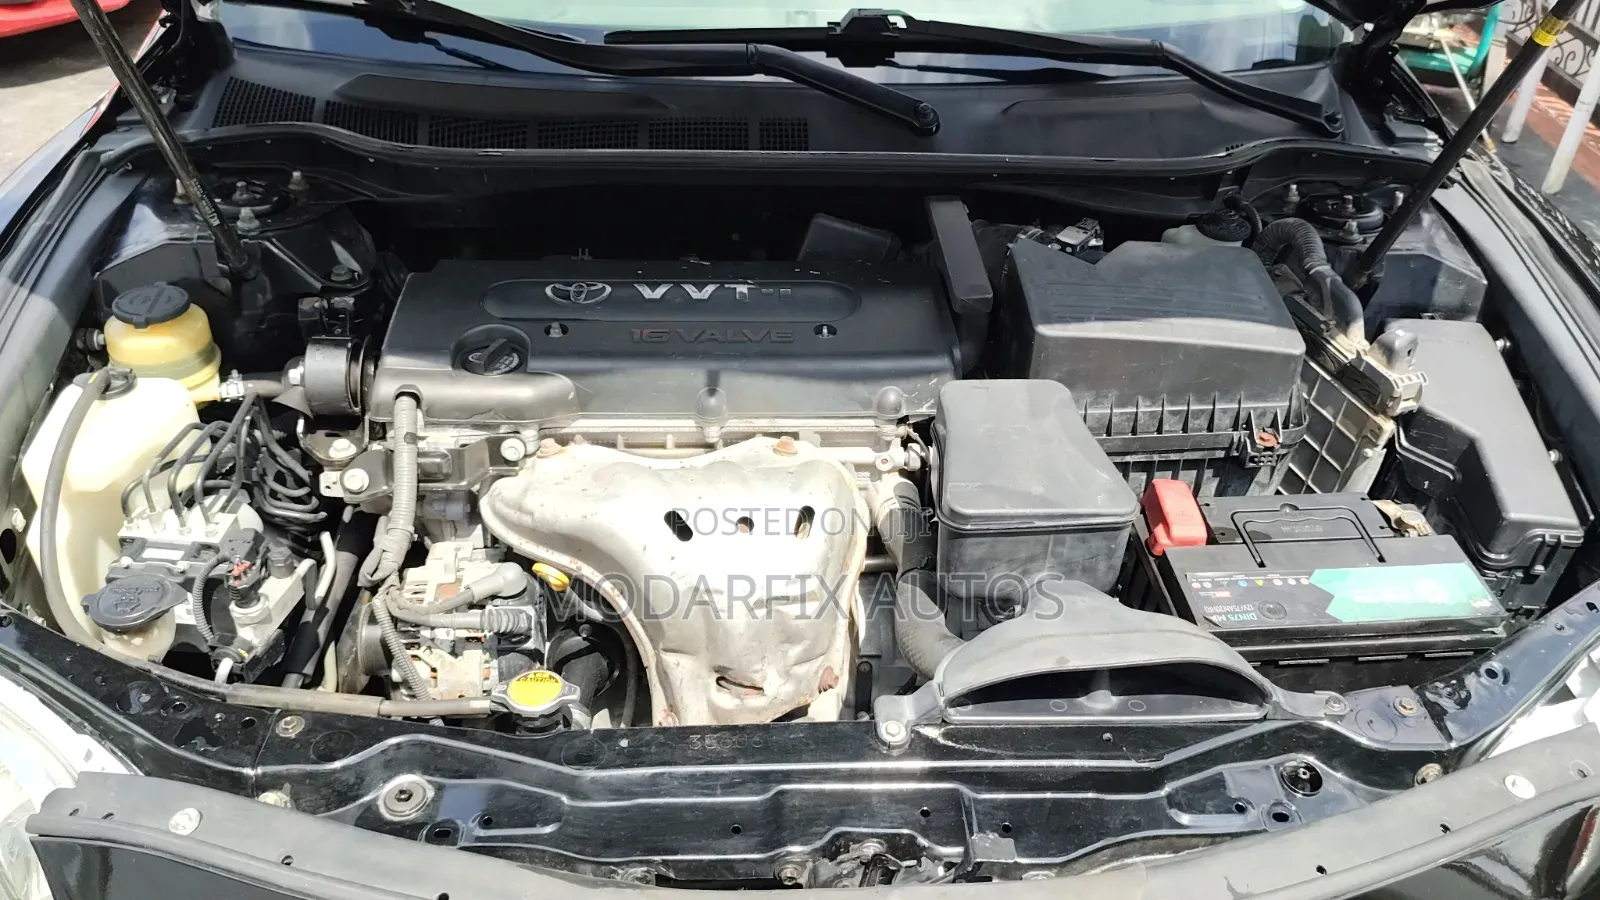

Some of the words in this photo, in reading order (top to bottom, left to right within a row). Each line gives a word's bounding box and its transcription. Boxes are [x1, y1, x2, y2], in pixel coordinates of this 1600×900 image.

[631, 328, 670, 343] 16
[676, 328, 795, 343] VALVE
[1227, 612, 1258, 622] DIN75
